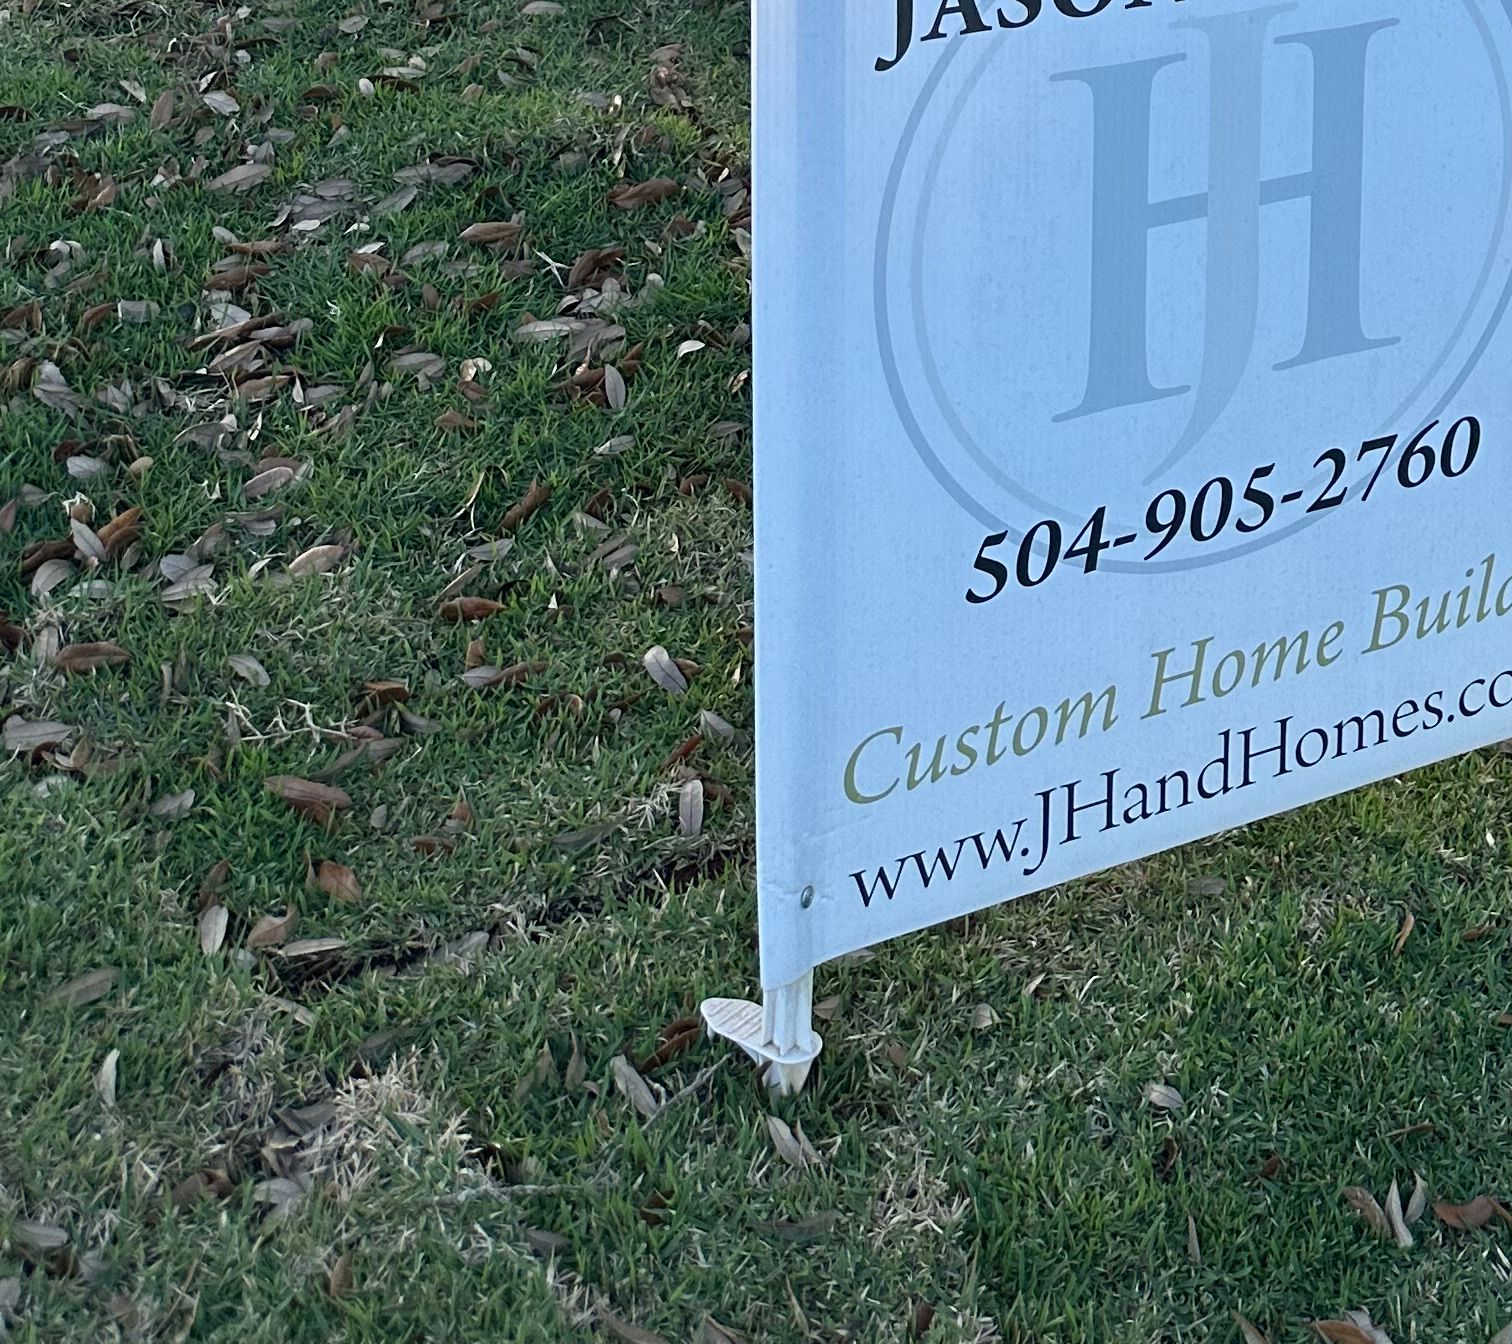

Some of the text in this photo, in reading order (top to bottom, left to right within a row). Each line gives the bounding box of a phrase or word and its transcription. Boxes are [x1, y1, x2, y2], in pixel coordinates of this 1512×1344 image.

[965, 415, 1481, 604] 504-905-2760
[843, 684, 1118, 805] Custom
[1141, 618, 1344, 719] Home
